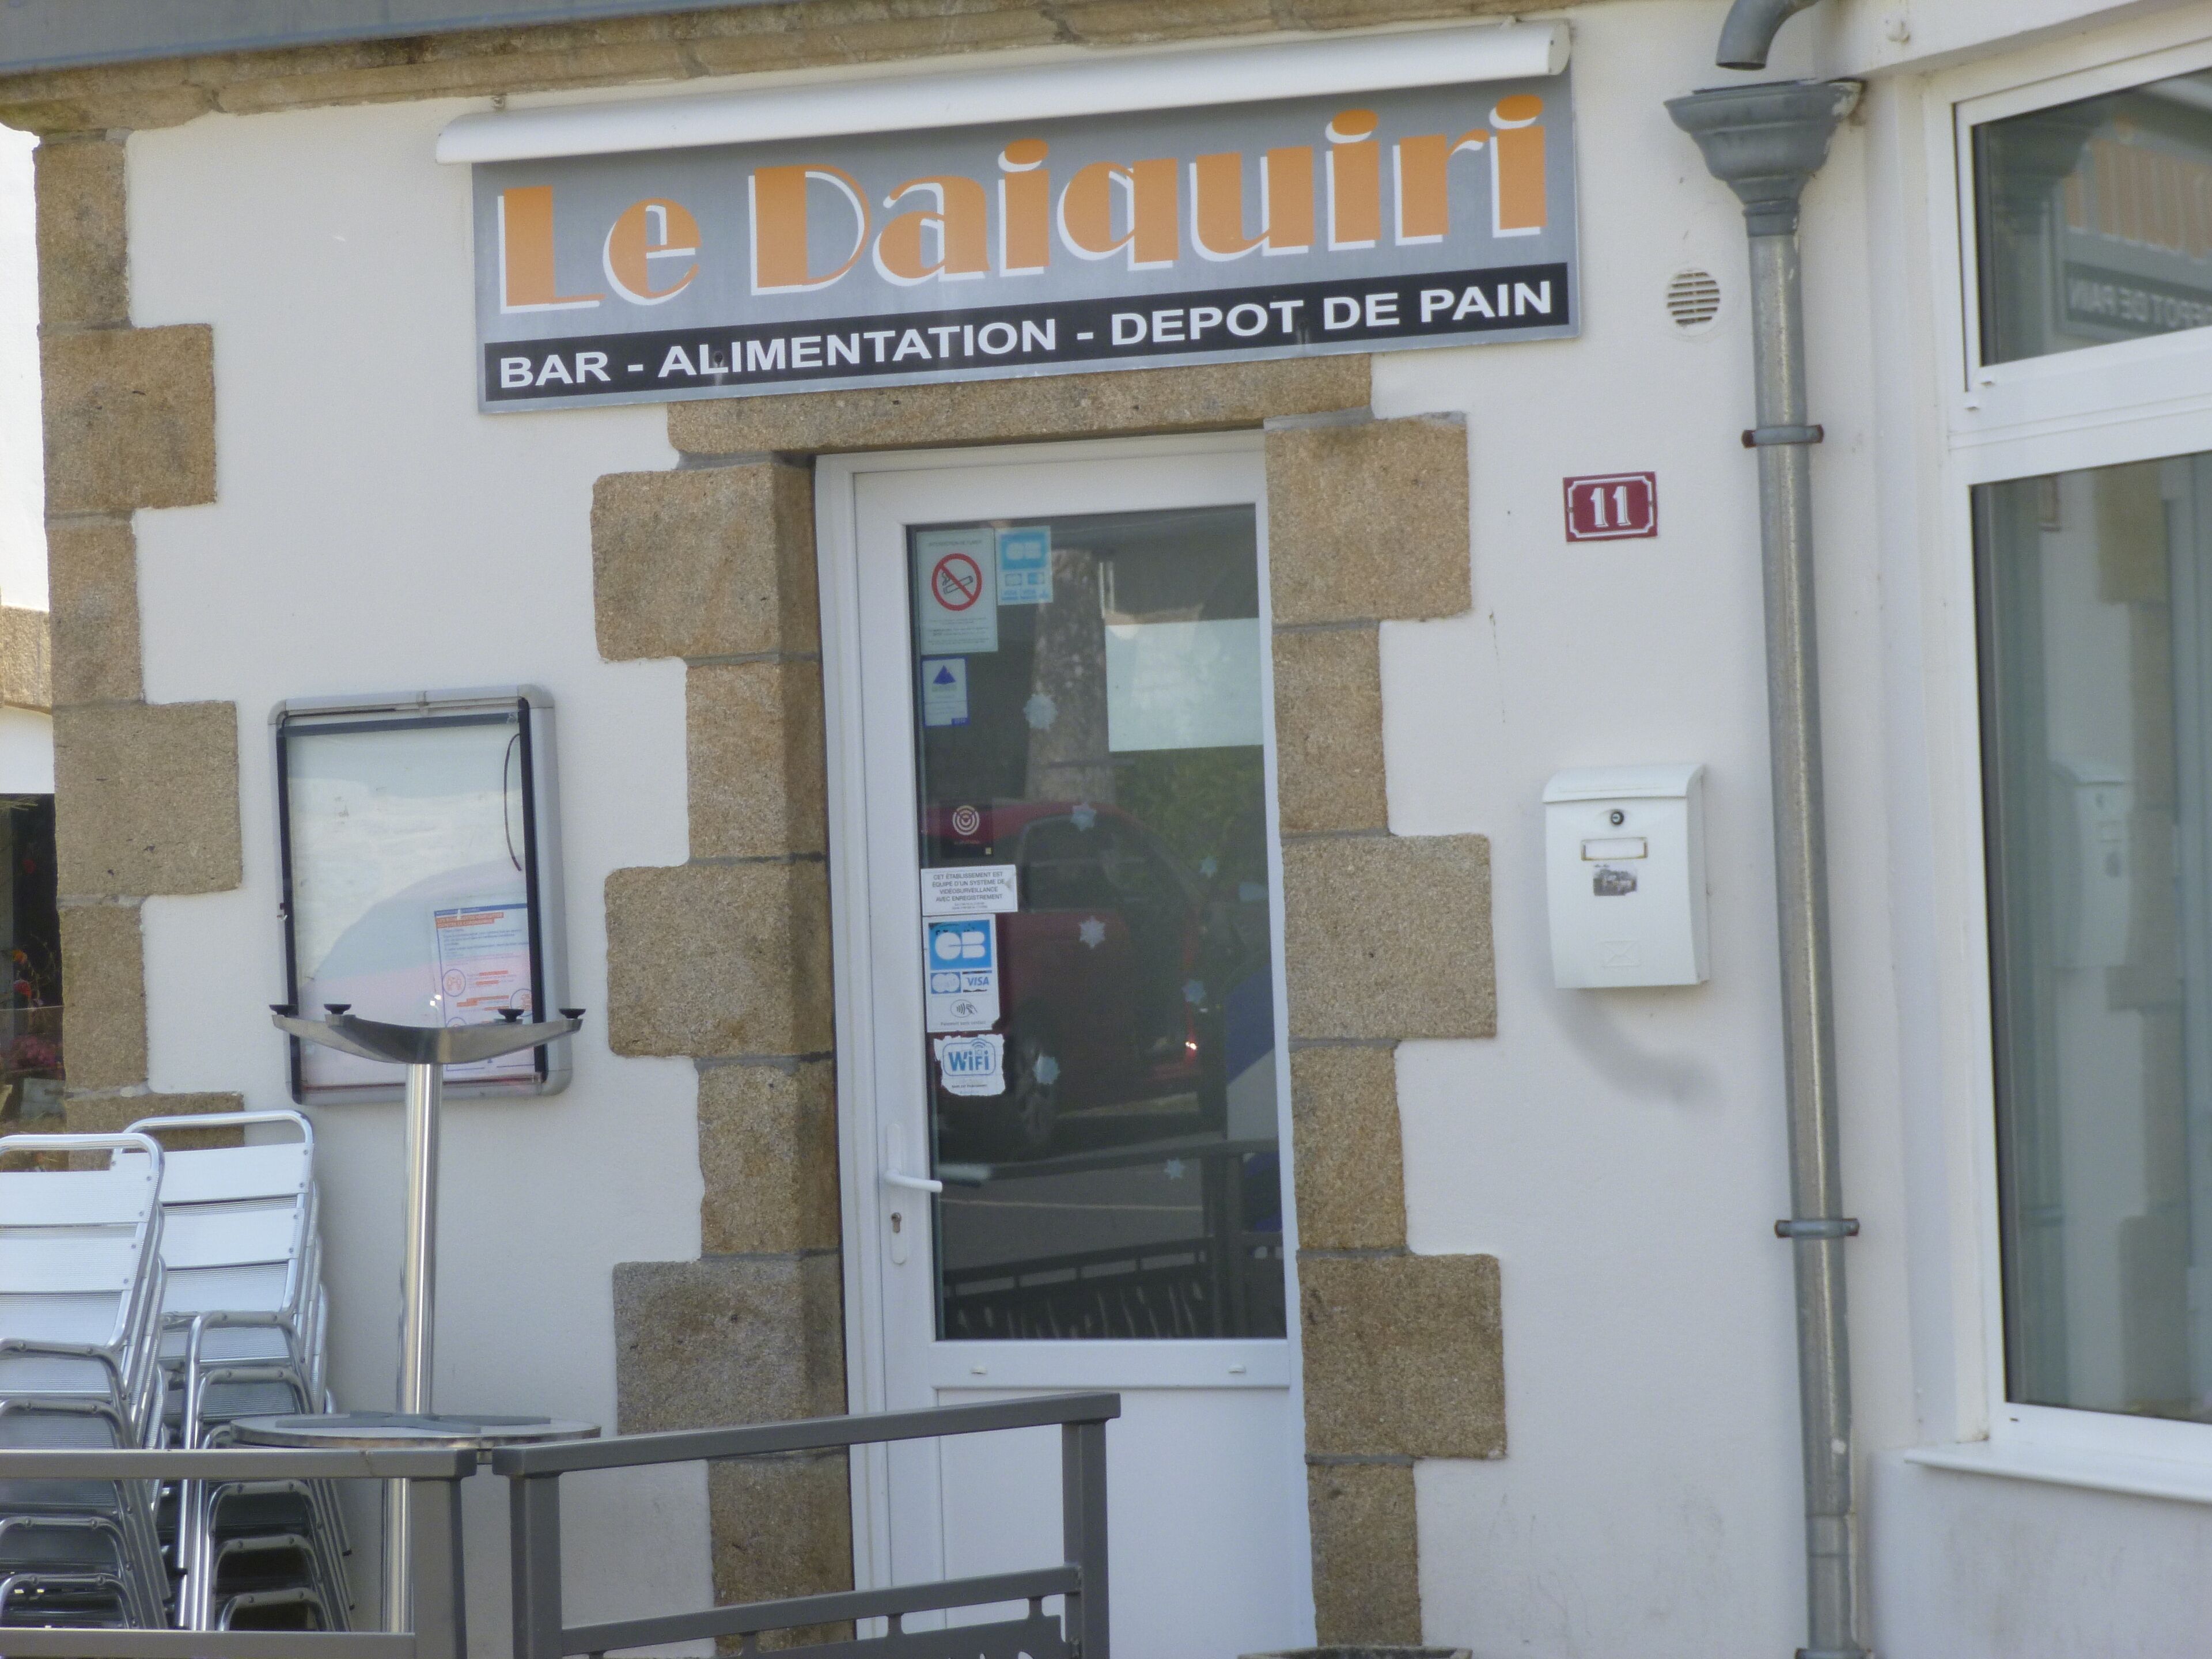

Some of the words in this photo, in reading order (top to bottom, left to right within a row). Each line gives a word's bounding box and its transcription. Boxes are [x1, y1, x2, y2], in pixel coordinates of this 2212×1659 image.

[497, 184, 702, 314] Le
[748, 94, 1548, 296] Daiquiri
[500, 351, 611, 390] BAR
[658, 319, 1057, 378] ALIMENTATION
[1111, 299, 1304, 346] DEPOT
[1323, 292, 1400, 331] DE
[1419, 279, 1552, 323] PAIN
[1590, 485, 1631, 528] 11
[952, 893, 1003, 902] ENREGISTREMENT
[967, 976, 990, 986] VISA
[948, 1050, 990, 1071] WiFi
